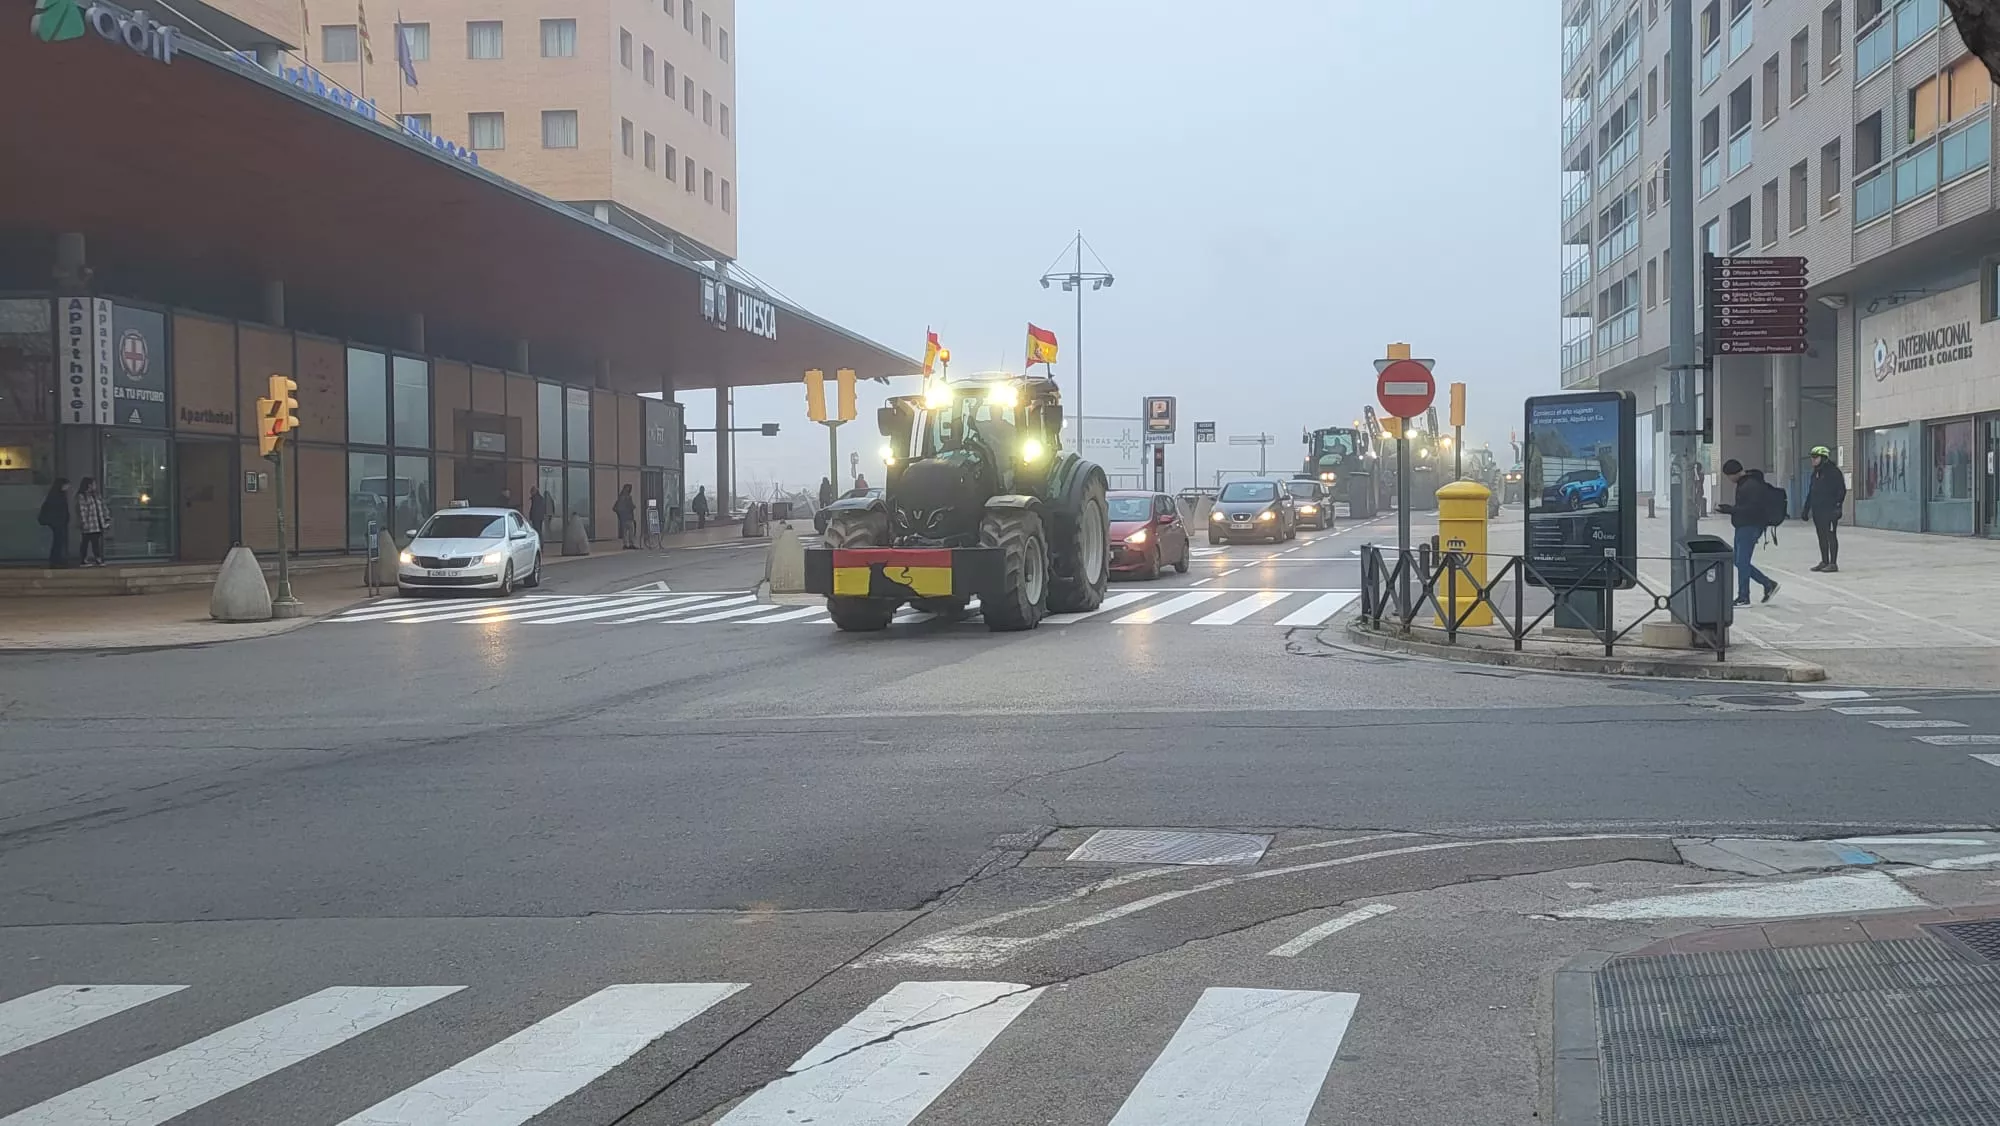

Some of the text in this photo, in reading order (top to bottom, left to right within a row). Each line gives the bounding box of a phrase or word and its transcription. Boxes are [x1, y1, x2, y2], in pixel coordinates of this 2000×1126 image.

[737, 290, 777, 341] HUESCA
[1898, 320, 1973, 360] INTERNACIONAL
[68, 299, 84, 422] Aparthotel
[99, 300, 109, 424] Aparthotel
[1898, 355, 1928, 374] PLAYERS
[1937, 345, 1973, 365] COACHES
[125, 387, 136, 399] TU
[136, 389, 165, 402] FUTURO
[181, 407, 234, 425] Aparthotel
[1066, 437, 1111, 445] HAINERAS
